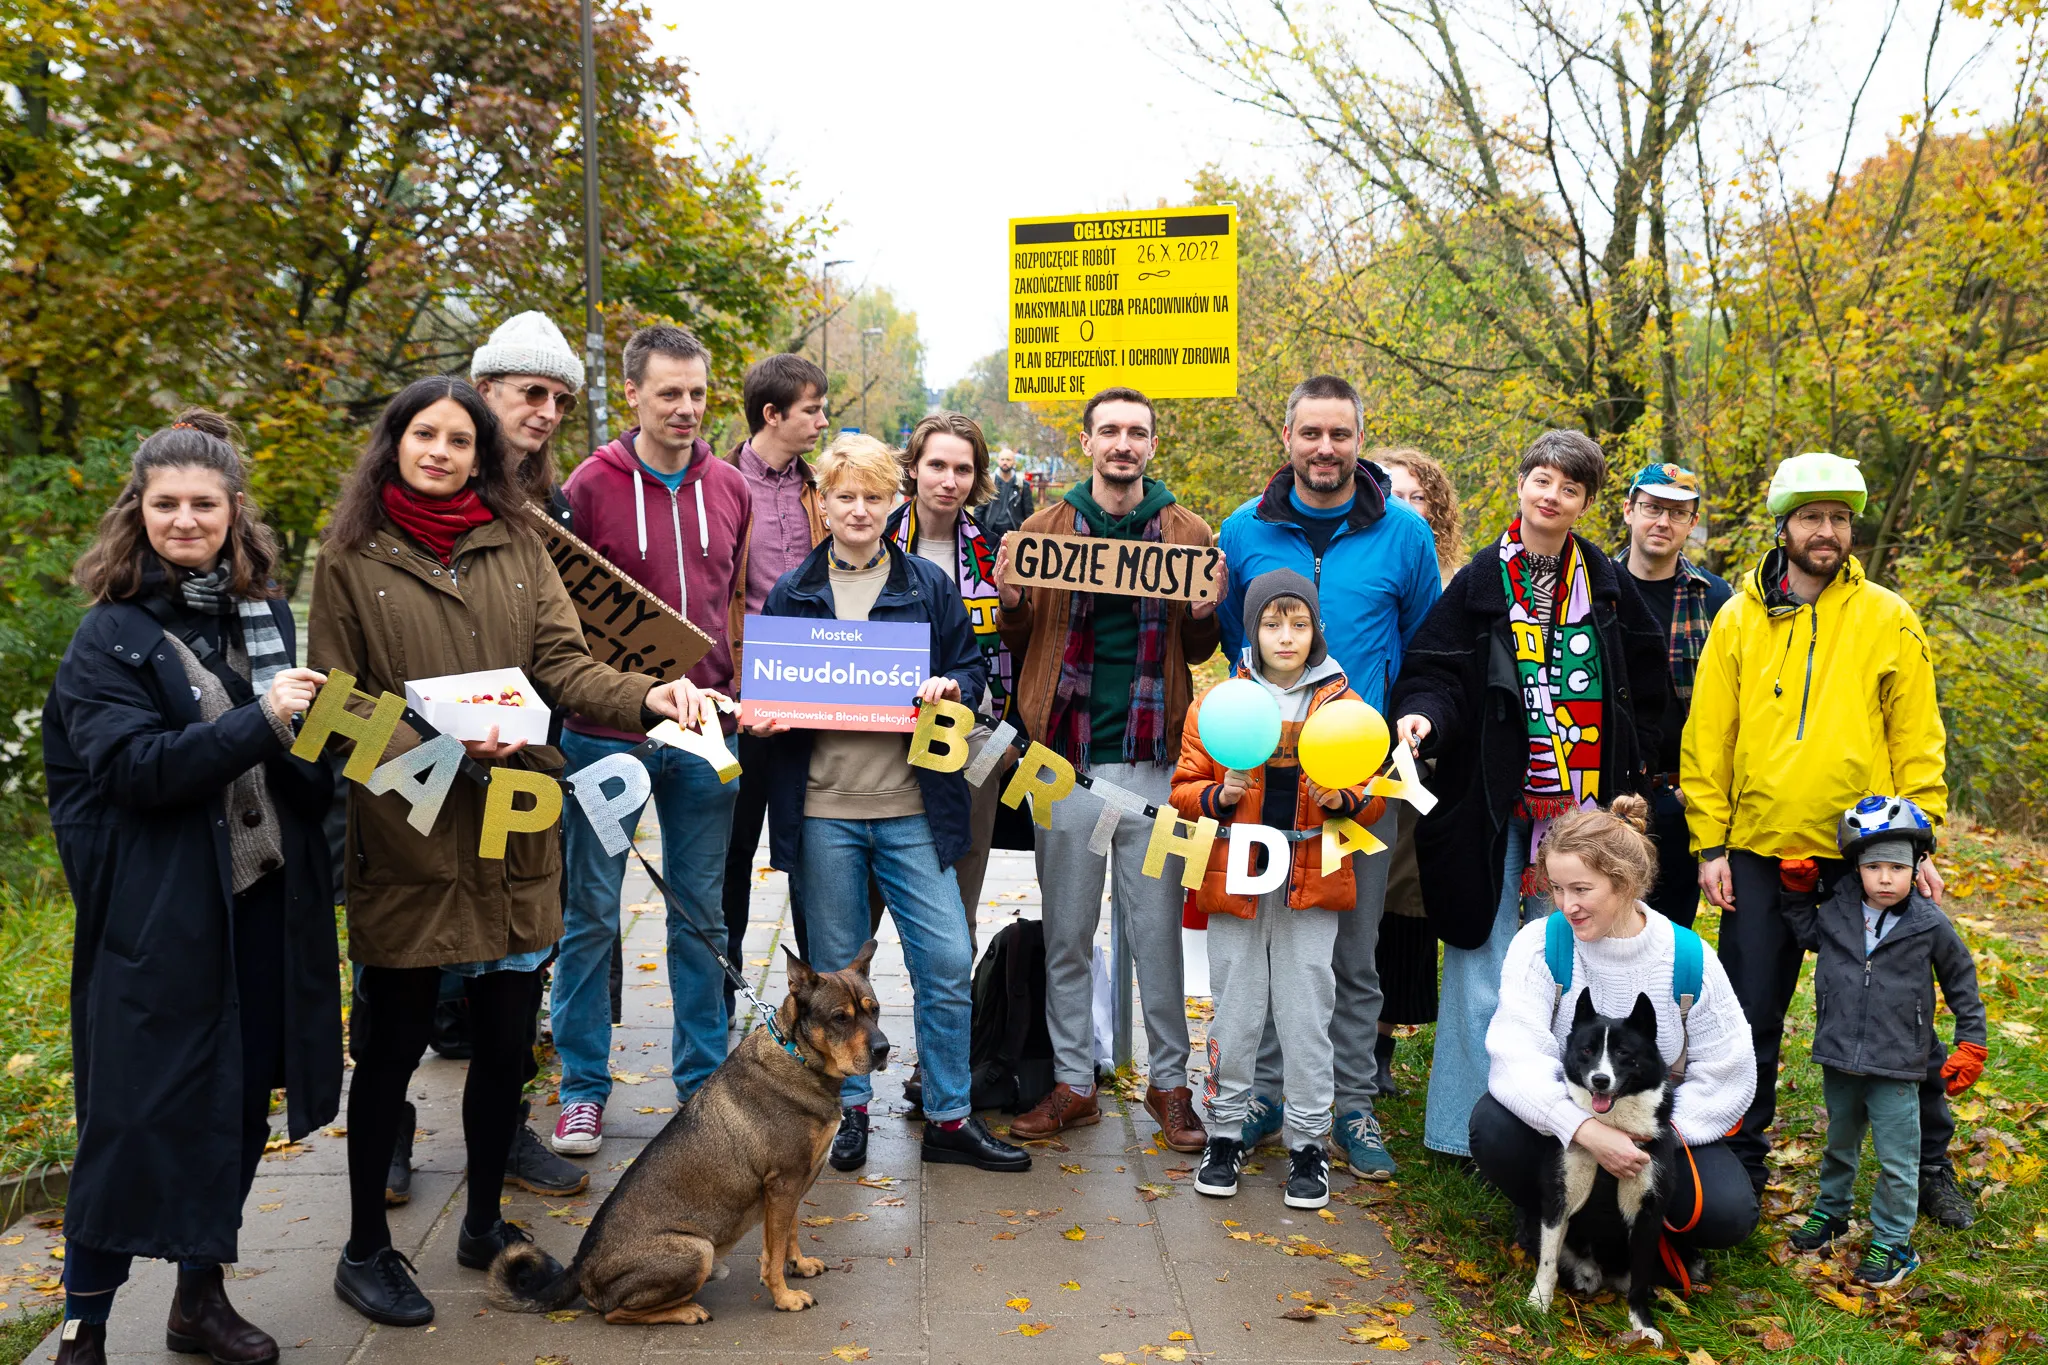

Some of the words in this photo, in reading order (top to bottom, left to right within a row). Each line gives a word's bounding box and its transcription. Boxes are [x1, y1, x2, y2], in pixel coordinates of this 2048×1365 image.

[1074, 219, 1166, 241] OGŁOSZENIE
[1015, 250, 1078, 270] ROZPOCZĘCIE
[1082, 245, 1116, 266] ROBÓT
[1015, 273, 1081, 294] ZAKOŃCZENIE
[1085, 270, 1119, 291] ROBÓT
[1015, 300, 1087, 319] MAKSYMALNA
[1090, 298, 1124, 317] LICZBA
[1128, 293, 1210, 315] PRACOWNIKÓW
[1213, 295, 1229, 312] NA
[1015, 326, 1060, 344] BUDOWIE
[1015, 352, 1042, 369] PLAN
[1045, 347, 1118, 368] BEZPIECZEŃST.
[1121, 349, 1125, 366] I
[1128, 348, 1179, 366] OCHRONY
[1182, 346, 1230, 365] ZDROWIA
[1015, 376, 1066, 394] ZNAJDUJE
[1069, 375, 1085, 395] SIĘ
[1014, 537, 1110, 586] GDZIE
[1115, 545, 1220, 599] MOST?
[811, 627, 863, 642] Mostek
[753, 658, 921, 687] Nieudolności
[754, 708, 833, 721] Kamionkowskie
[836, 709, 869, 723] Błonia
[871, 713, 917, 726] Elekcyjne
[290, 668, 743, 859] HAPPY
[907, 697, 1438, 895] BIRTHDAY
